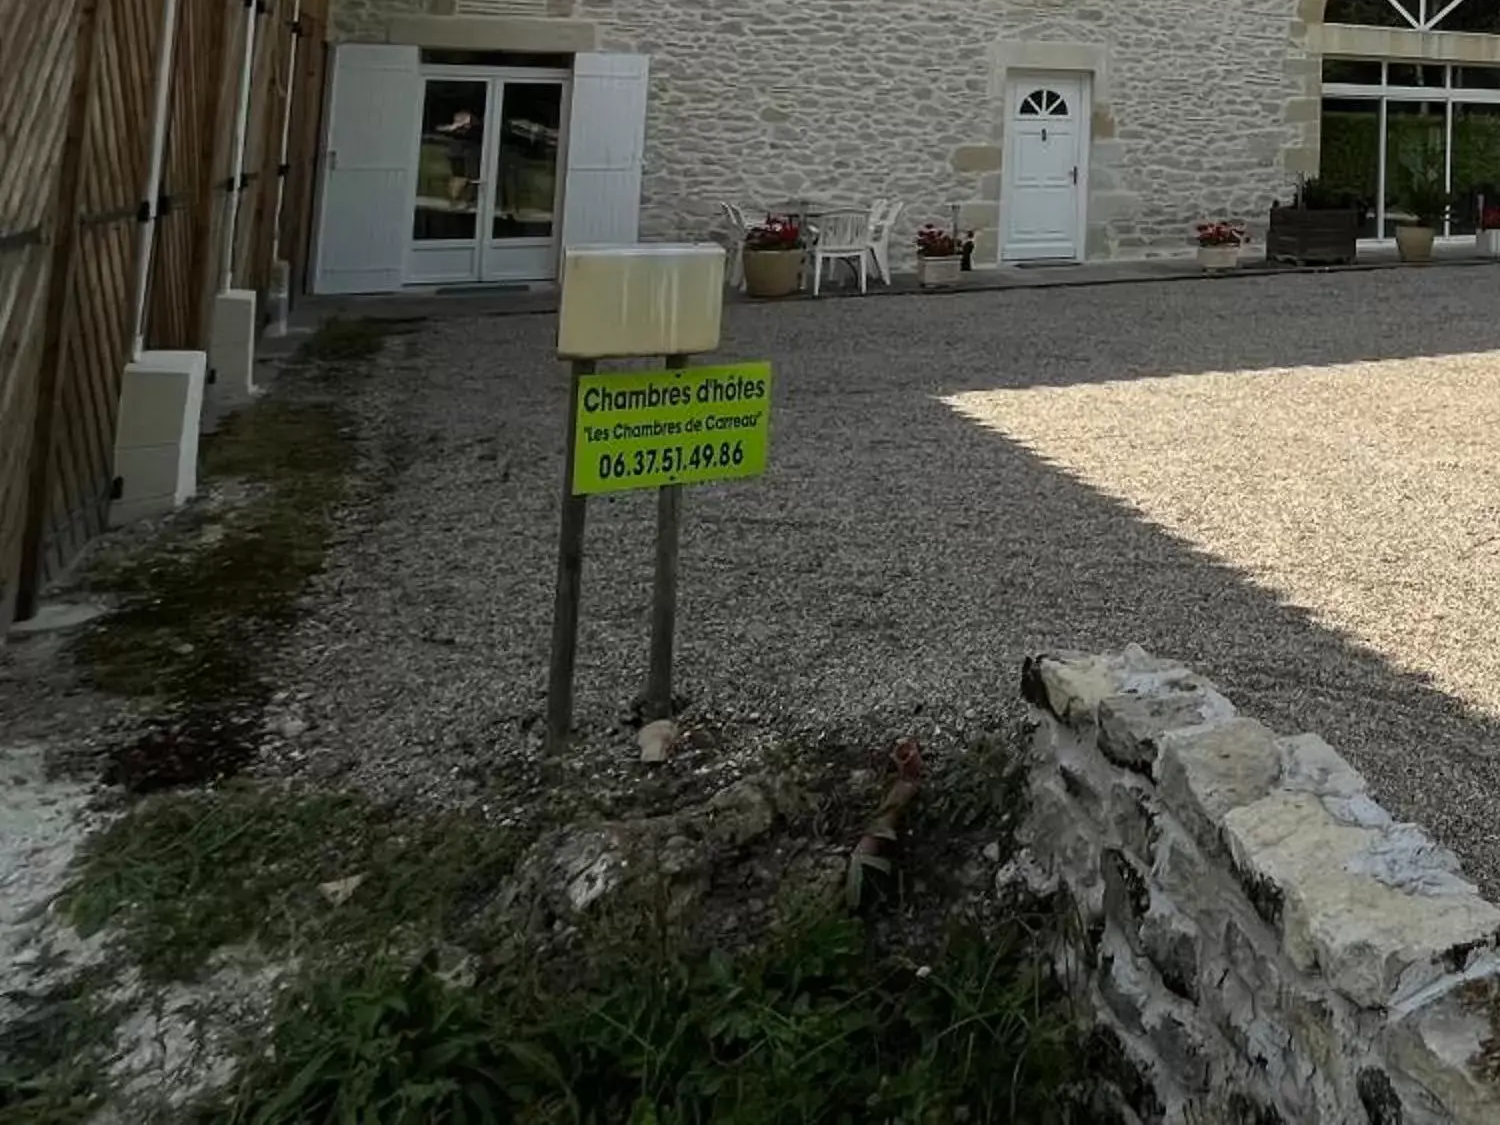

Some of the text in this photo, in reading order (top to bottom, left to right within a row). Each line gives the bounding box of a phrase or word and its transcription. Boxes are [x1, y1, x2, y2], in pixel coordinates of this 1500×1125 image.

[583, 375, 766, 412] Chambres d'hôtes
[613, 420, 682, 440] Chambres
[685, 416, 703, 433] de
[599, 439, 744, 479] 06.37.51.49.86
